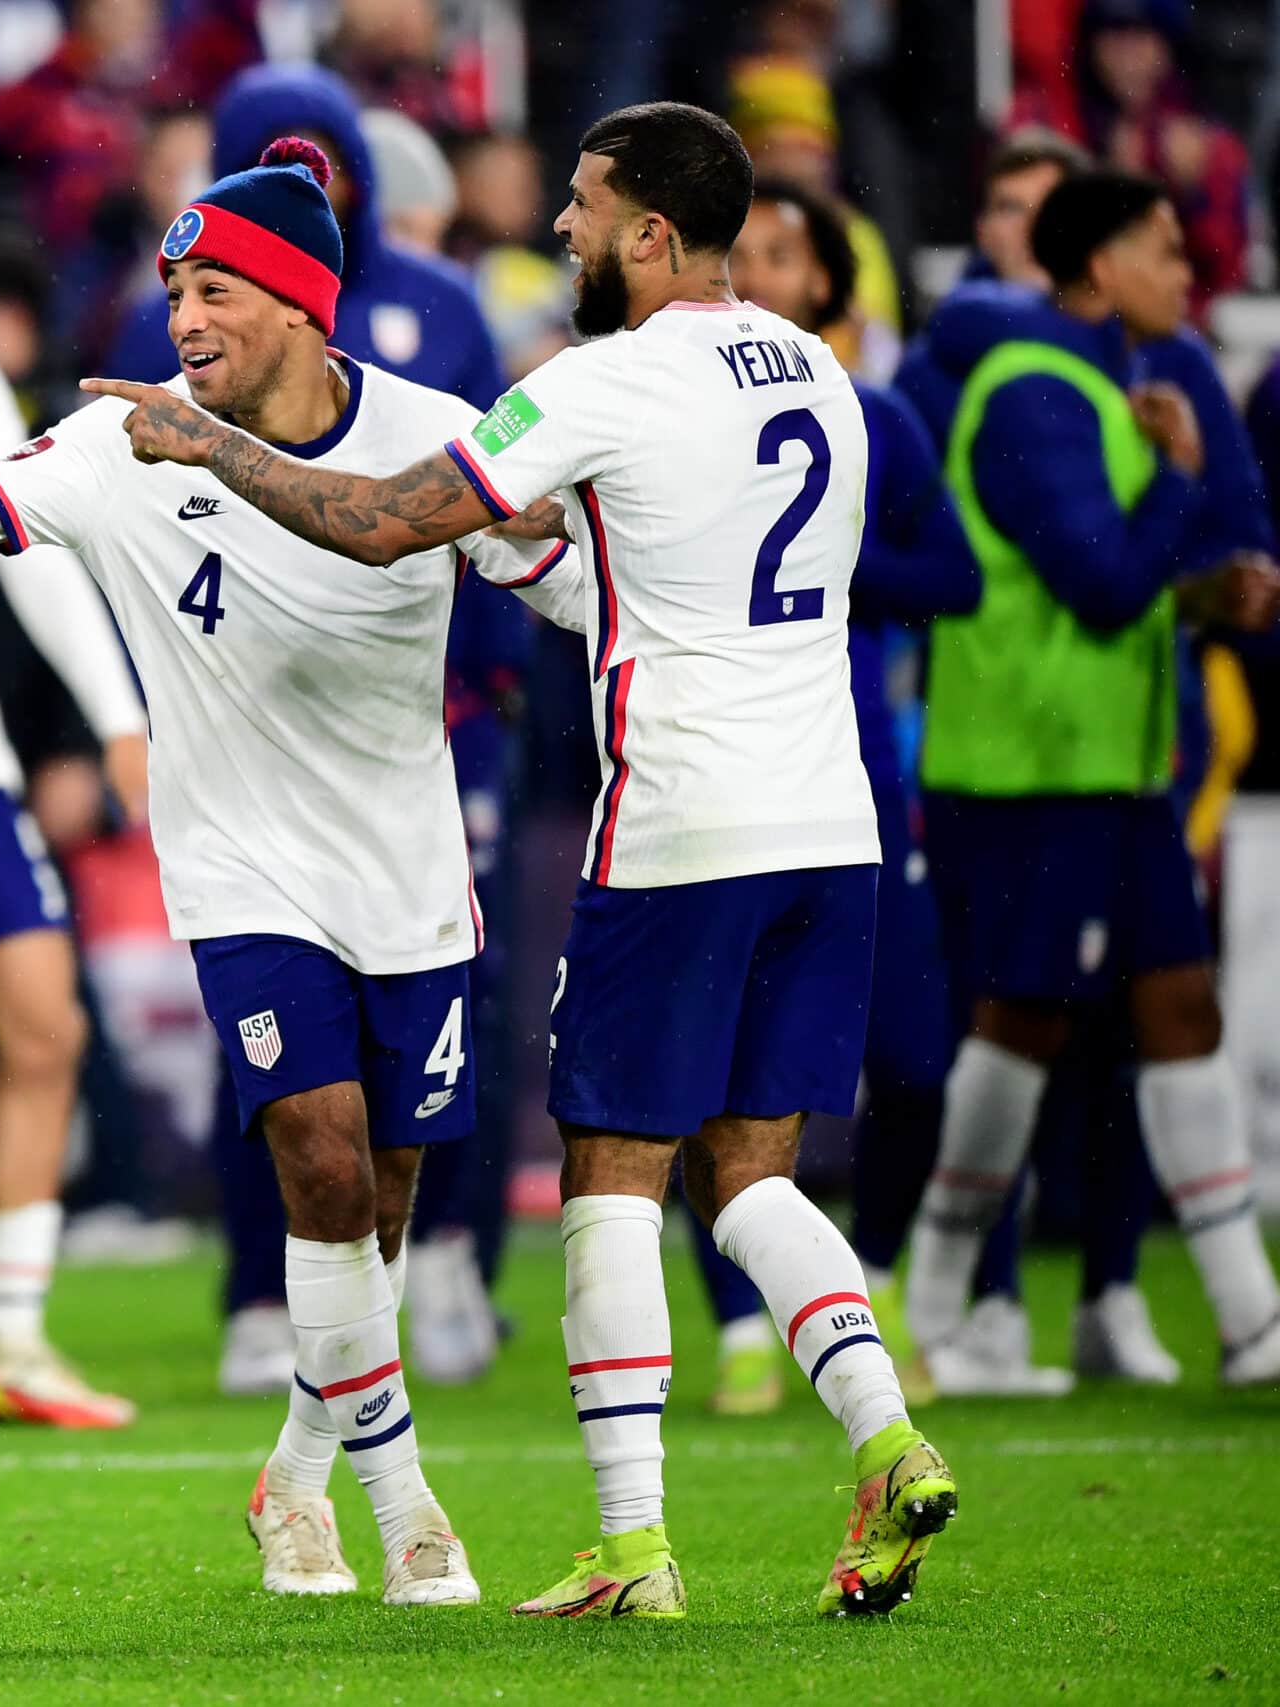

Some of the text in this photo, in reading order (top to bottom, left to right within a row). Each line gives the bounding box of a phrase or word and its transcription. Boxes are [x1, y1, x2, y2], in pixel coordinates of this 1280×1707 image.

[186, 496, 222, 514] NIKE
[749, 408, 831, 627] 2
[178, 551, 226, 636] 4
[241, 1014, 274, 1039] USA
[423, 996, 466, 1086] 4
[831, 1312, 873, 1331] USA
[361, 1388, 391, 1416] NIKE
